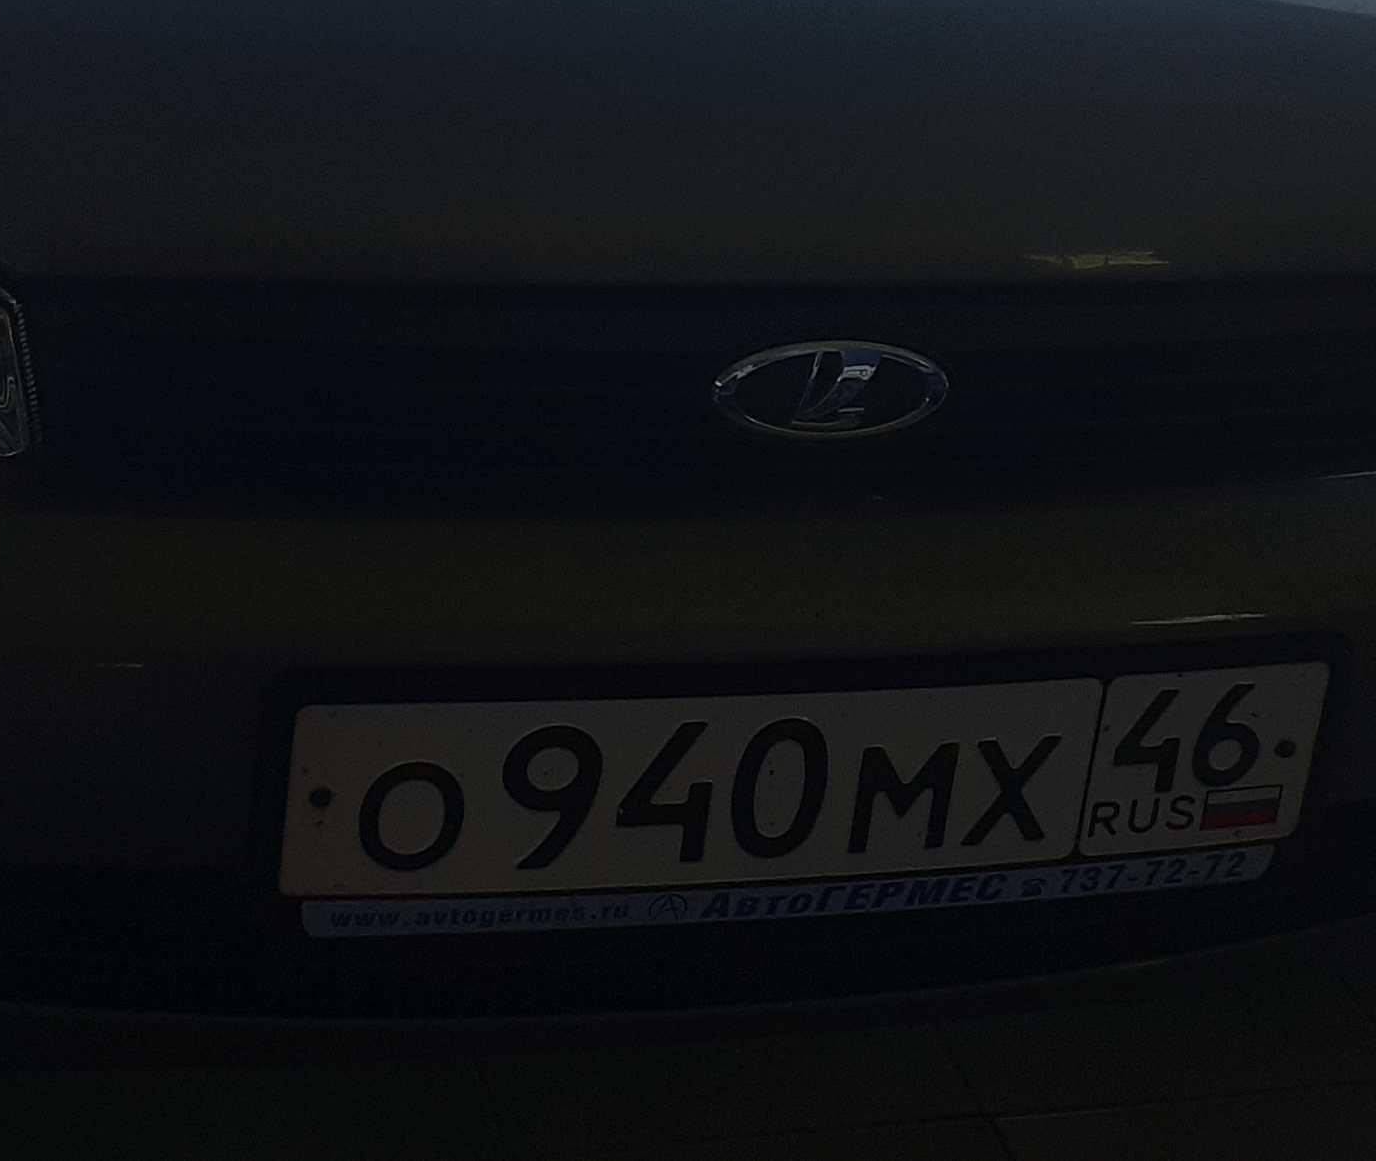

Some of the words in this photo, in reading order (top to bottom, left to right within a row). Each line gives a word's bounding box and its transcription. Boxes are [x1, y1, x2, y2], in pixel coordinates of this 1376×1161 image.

[1111, 682, 1261, 795] 46
[1086, 792, 1198, 839] RUS
[1059, 851, 1249, 895] 737-72-72
[330, 902, 631, 930] www.avtogermes.ru
